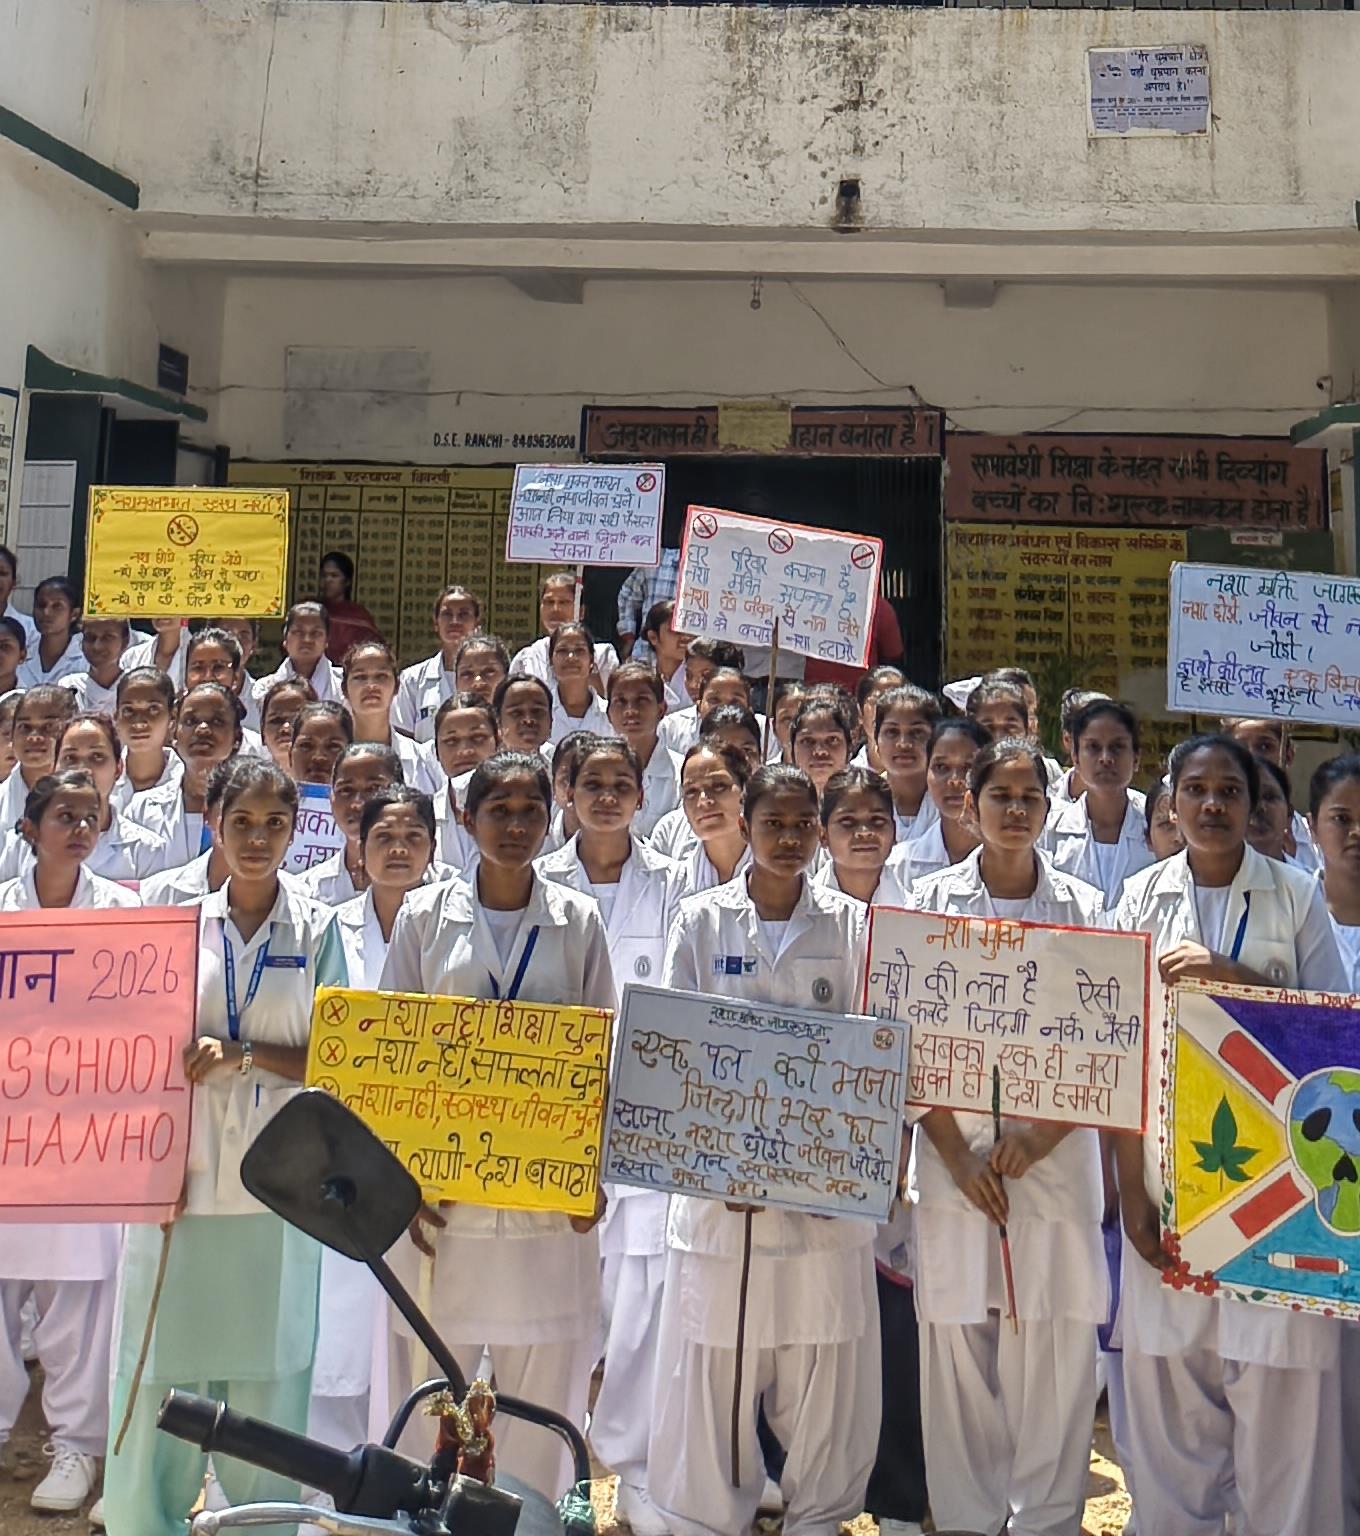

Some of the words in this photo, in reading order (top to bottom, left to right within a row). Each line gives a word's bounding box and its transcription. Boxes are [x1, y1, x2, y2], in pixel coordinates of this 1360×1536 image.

[1207, 573, 1252, 597] नशा
[1248, 600, 1304, 631] जीवन
[1312, 603, 1334, 634] से
[927, 919, 971, 951] नशा
[87, 942, 180, 1002] 2026
[925, 960, 959, 999] की
[966, 972, 1009, 1006] लत
[1017, 960, 1038, 1005] है
[1075, 968, 1121, 1015] ऐसी
[358, 997, 436, 1039] नशा
[495, 999, 560, 1045] शिक्षा
[1096, 1012, 1141, 1052] जैसी
[0, 1032, 187, 1100] SCHOOL
[352, 1037, 420, 1075] नशा
[471, 1048, 569, 1088] सफलता
[998, 1042, 1038, 1076] एक
[1044, 1043, 1068, 1081] ही
[1075, 1052, 1127, 1089] नारा
[344, 1082, 399, 1119] नशा
[511, 1091, 573, 1130] जीवन
